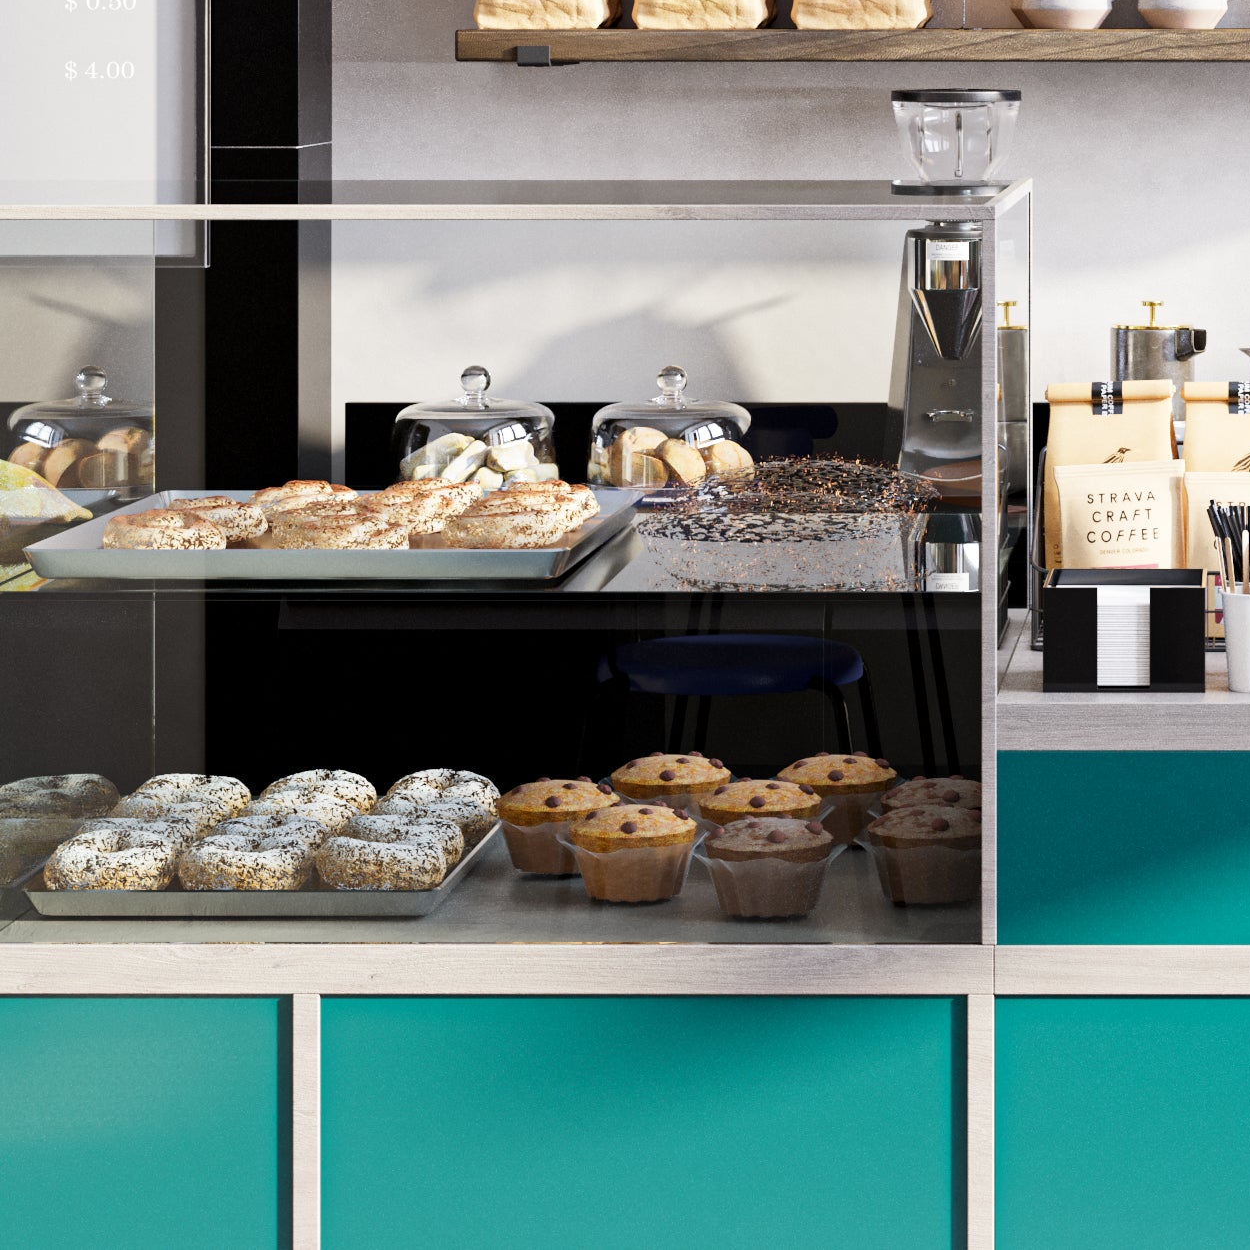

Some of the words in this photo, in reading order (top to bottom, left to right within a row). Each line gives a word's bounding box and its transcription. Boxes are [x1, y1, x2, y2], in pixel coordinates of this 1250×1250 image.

[65, 60, 77, 81] $
[85, 62, 134, 79] 4.00
[1087, 491, 1155, 504] STRAVA
[1092, 509, 1152, 522] CRAFT
[1086, 528, 1159, 543] COFFEE
